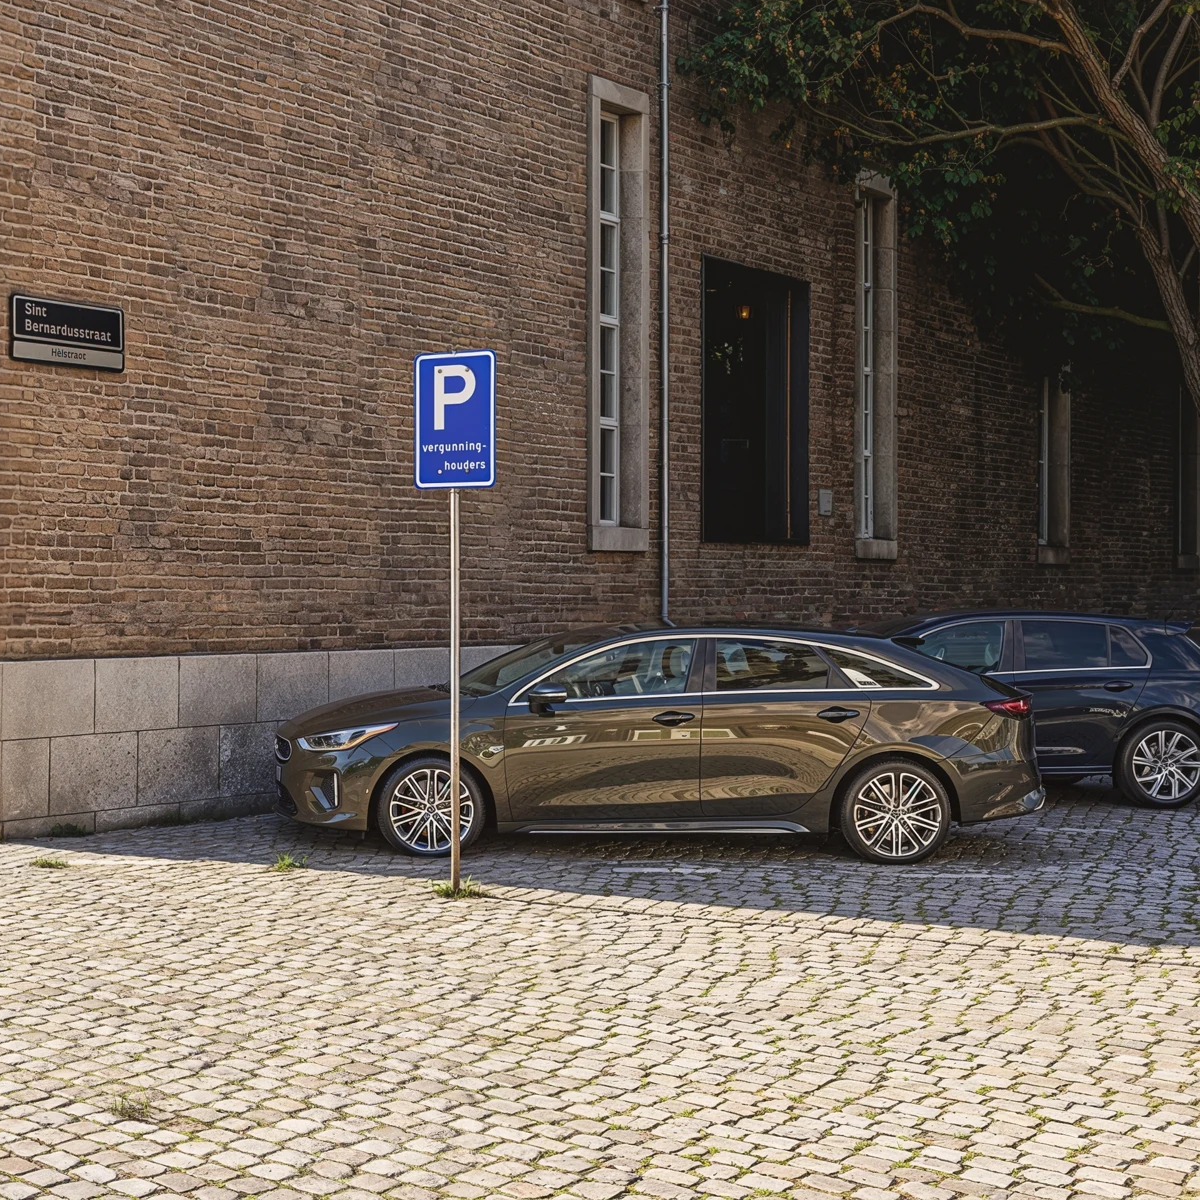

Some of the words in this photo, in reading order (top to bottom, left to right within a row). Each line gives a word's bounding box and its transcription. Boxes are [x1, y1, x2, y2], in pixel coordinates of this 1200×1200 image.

[24, 302, 47, 317] Sint
[24, 318, 112, 342] Bernardusstraat
[434, 364, 476, 431] P
[422, 441, 487, 454] vergunning-
[444, 460, 486, 470] houders
